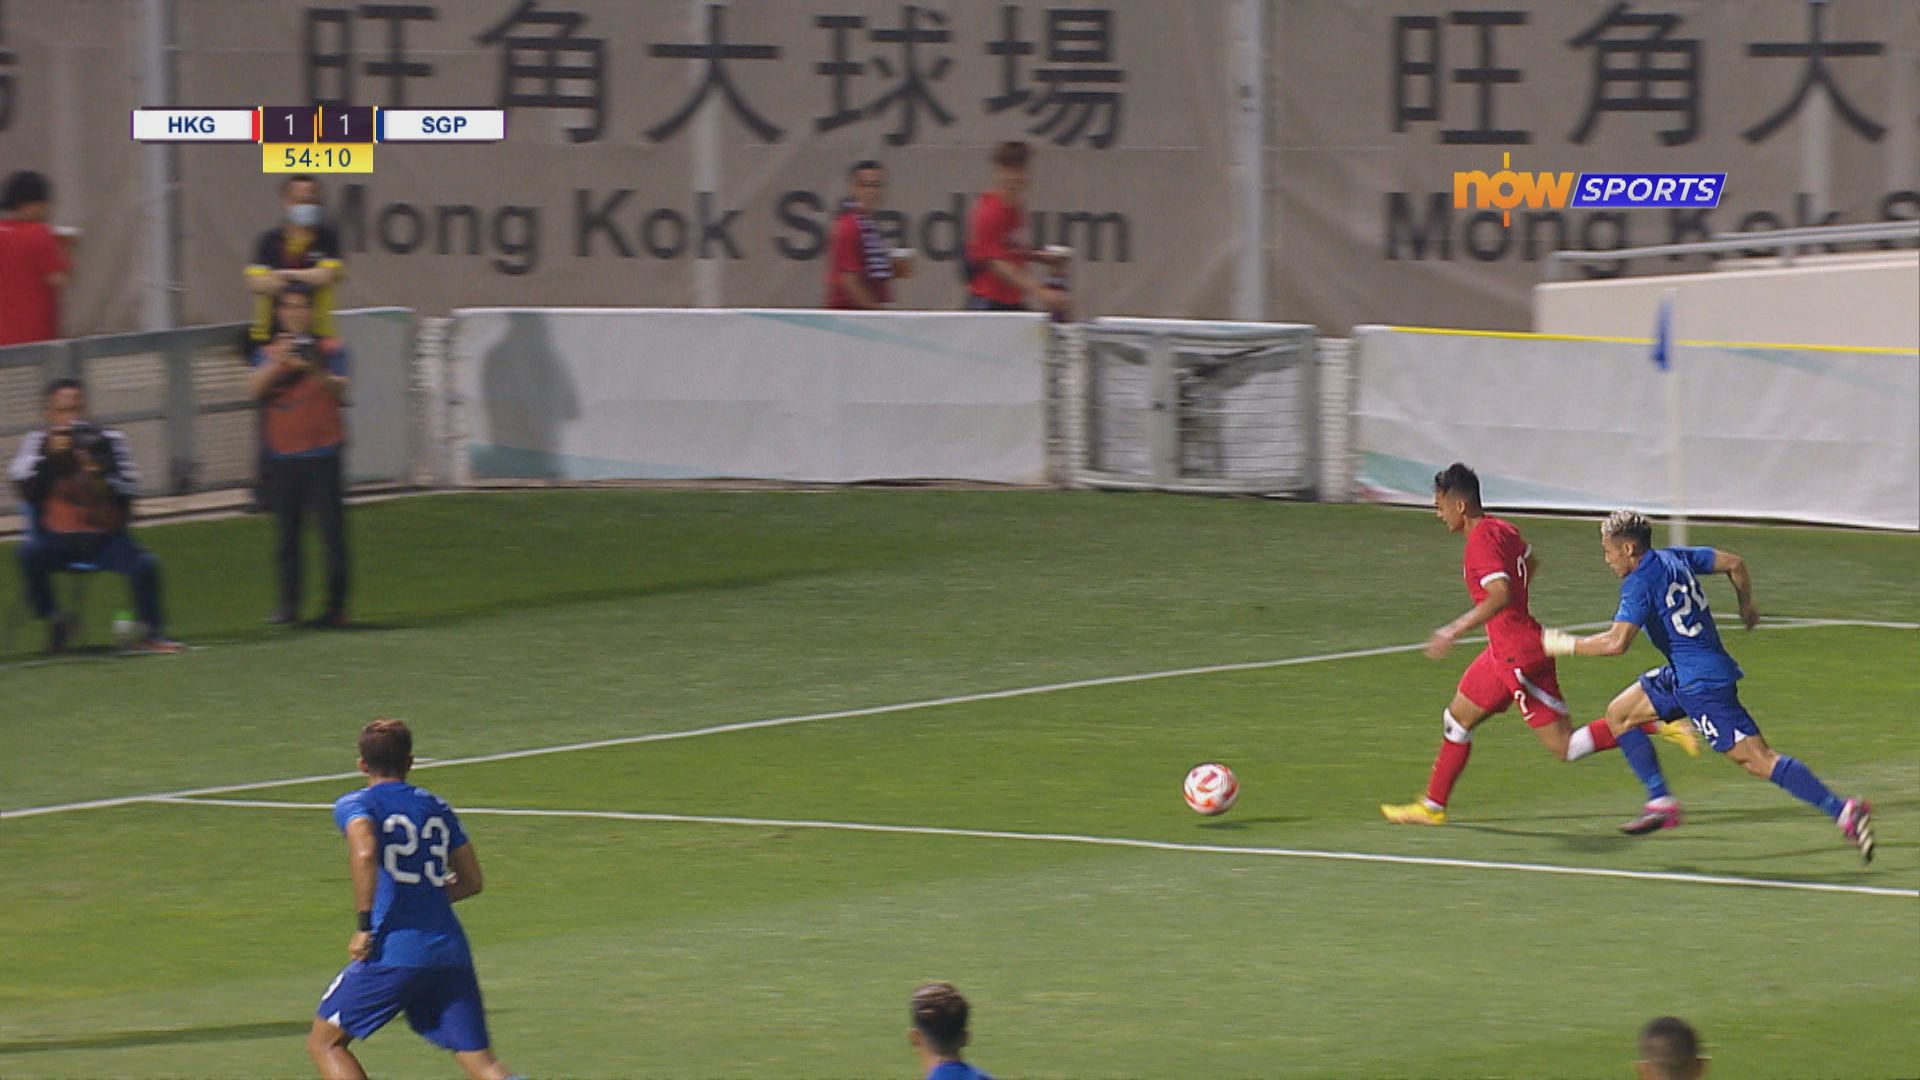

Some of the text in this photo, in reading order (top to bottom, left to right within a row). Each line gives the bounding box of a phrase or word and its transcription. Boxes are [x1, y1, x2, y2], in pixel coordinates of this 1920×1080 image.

[306, 1, 1126, 150] 旺角大球場
[575, 188, 743, 260] Kok
[383, 814, 450, 888] 23
